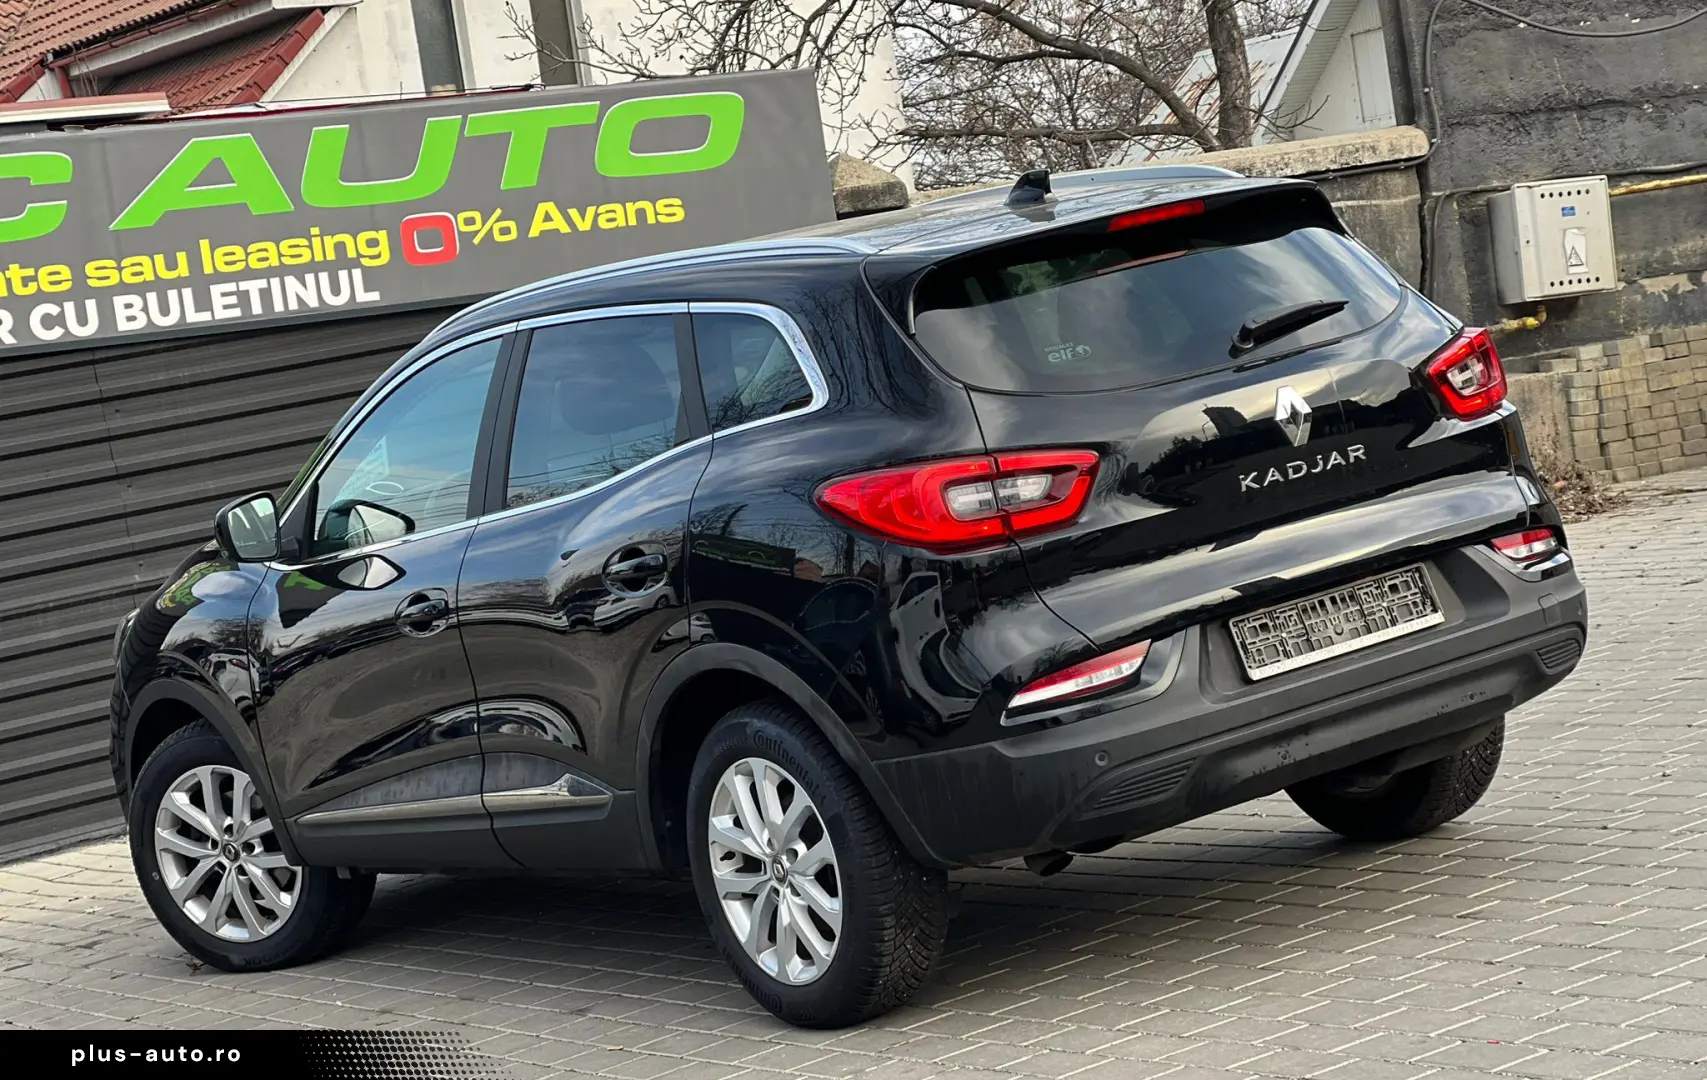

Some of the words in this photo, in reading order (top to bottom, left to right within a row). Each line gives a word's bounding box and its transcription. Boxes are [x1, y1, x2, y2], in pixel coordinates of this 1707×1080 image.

[108, 91, 745, 231] AUTO
[0, 263, 73, 298] te
[84, 251, 191, 289] sau
[200, 226, 391, 275] leasing
[527, 197, 686, 240] Avans
[29, 298, 99, 341] CU
[112, 267, 381, 332] BULETINUL
[1239, 444, 1367, 492] KADJAR
[753, 729, 820, 796] Continental
